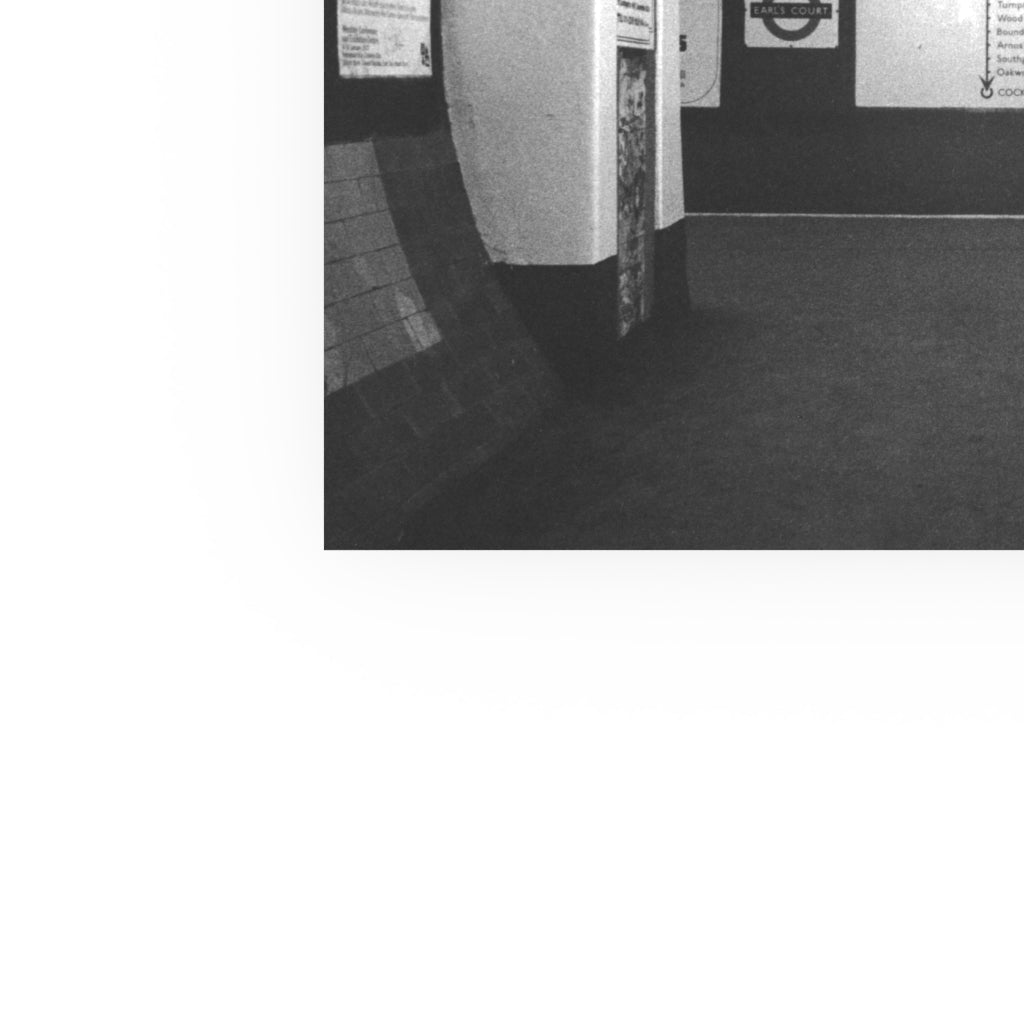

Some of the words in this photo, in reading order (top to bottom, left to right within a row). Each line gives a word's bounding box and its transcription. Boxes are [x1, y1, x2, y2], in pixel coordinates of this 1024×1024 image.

[790, 6, 829, 16] COURT
[998, 14, 1024, 23] Wood
[997, 41, 1023, 50] Arnos
